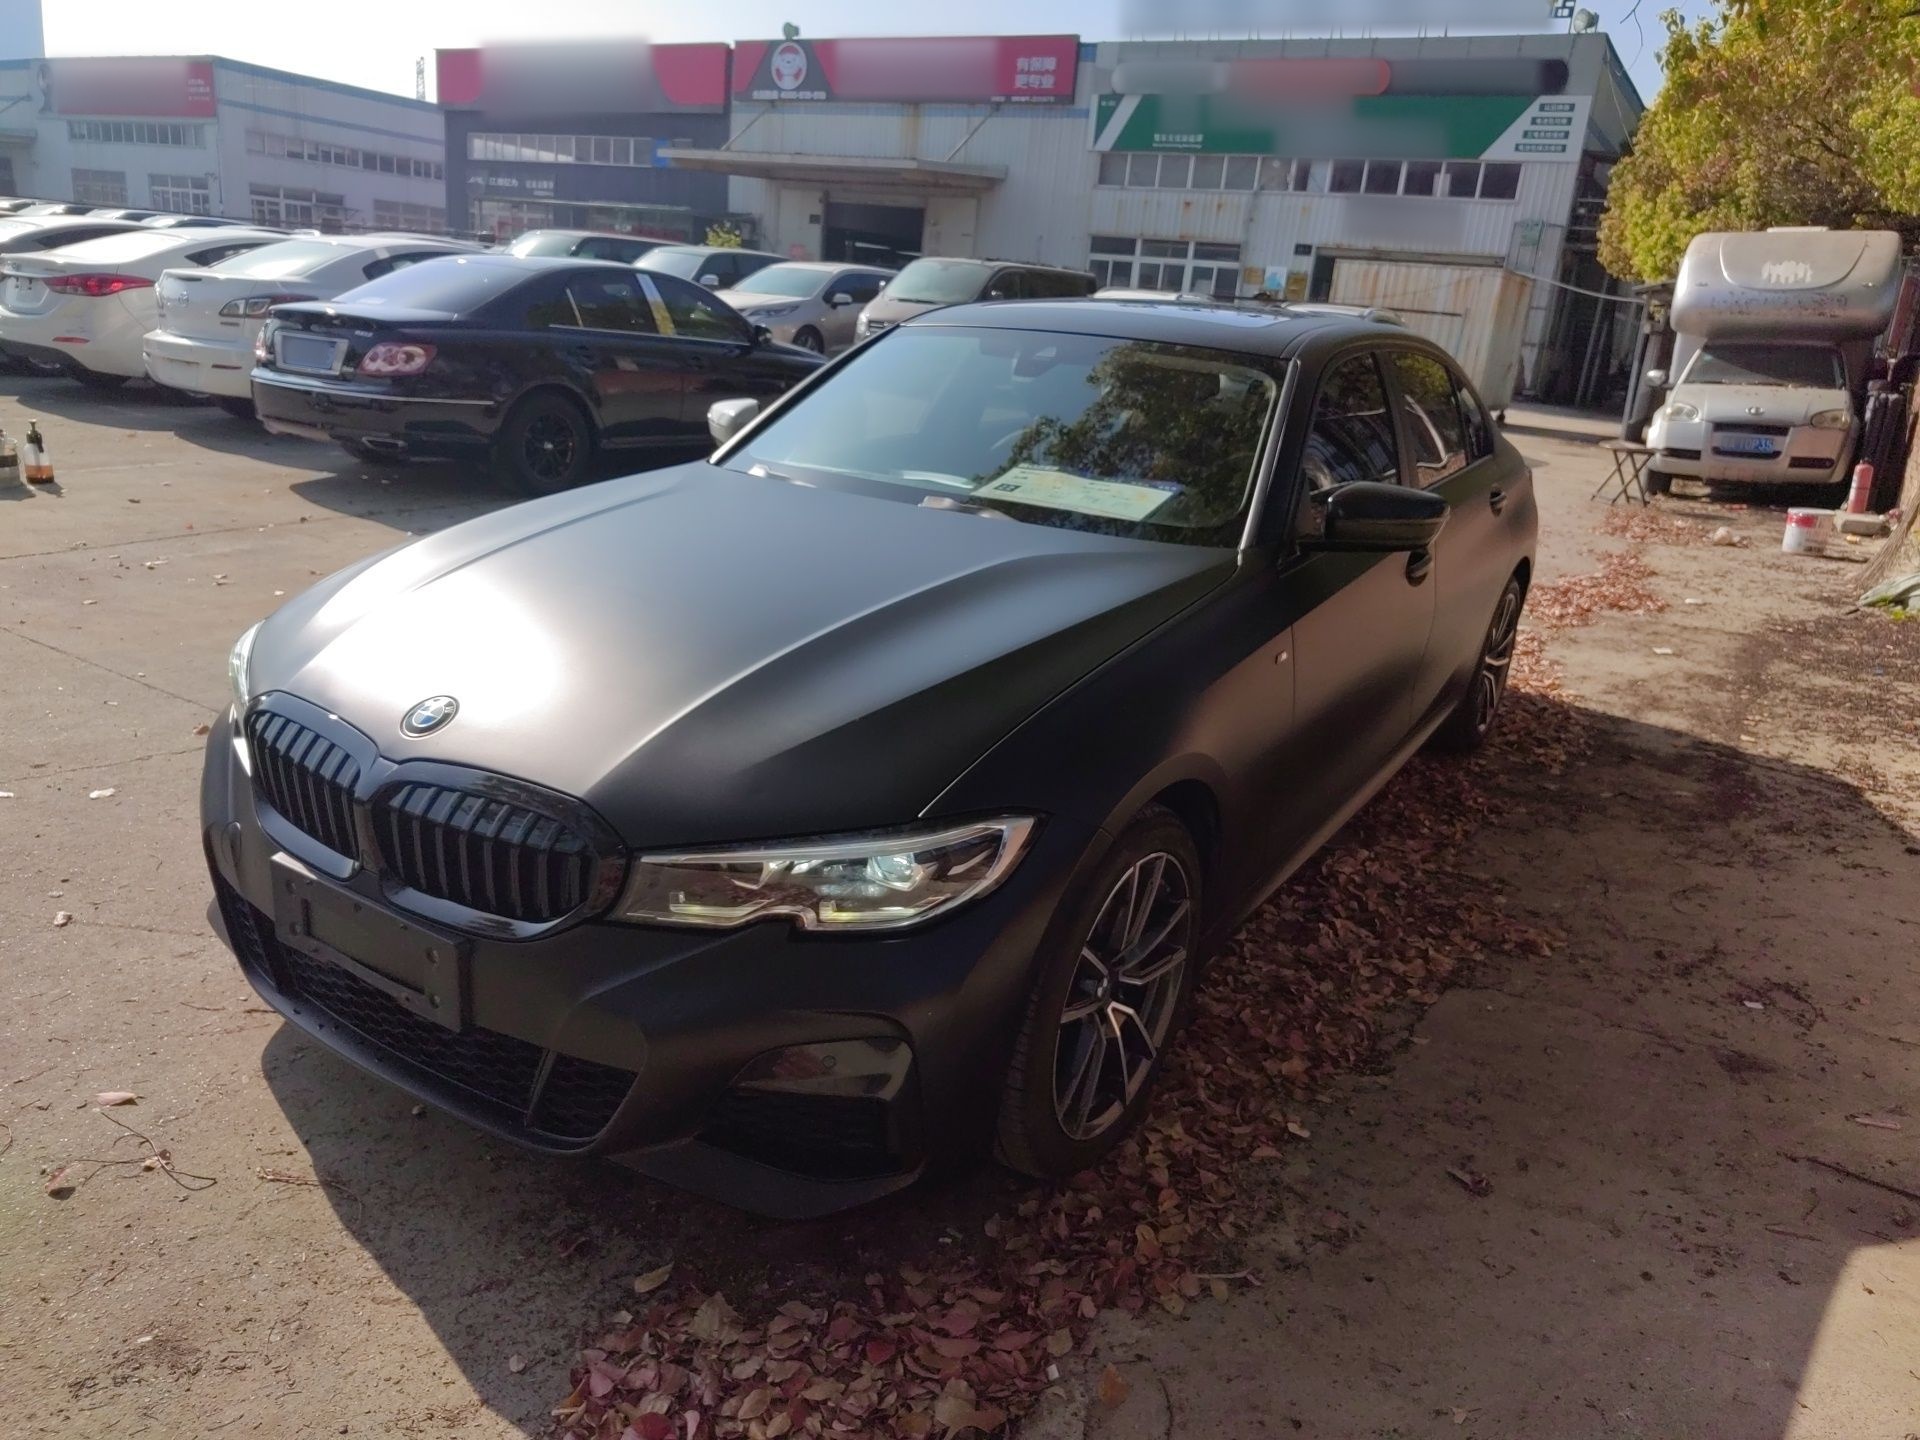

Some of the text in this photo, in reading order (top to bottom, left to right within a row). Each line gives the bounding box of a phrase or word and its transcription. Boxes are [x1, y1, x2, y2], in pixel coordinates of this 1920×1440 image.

[1016, 57, 1056, 72] 有保障
[1014, 74, 1055, 89] 更专业
